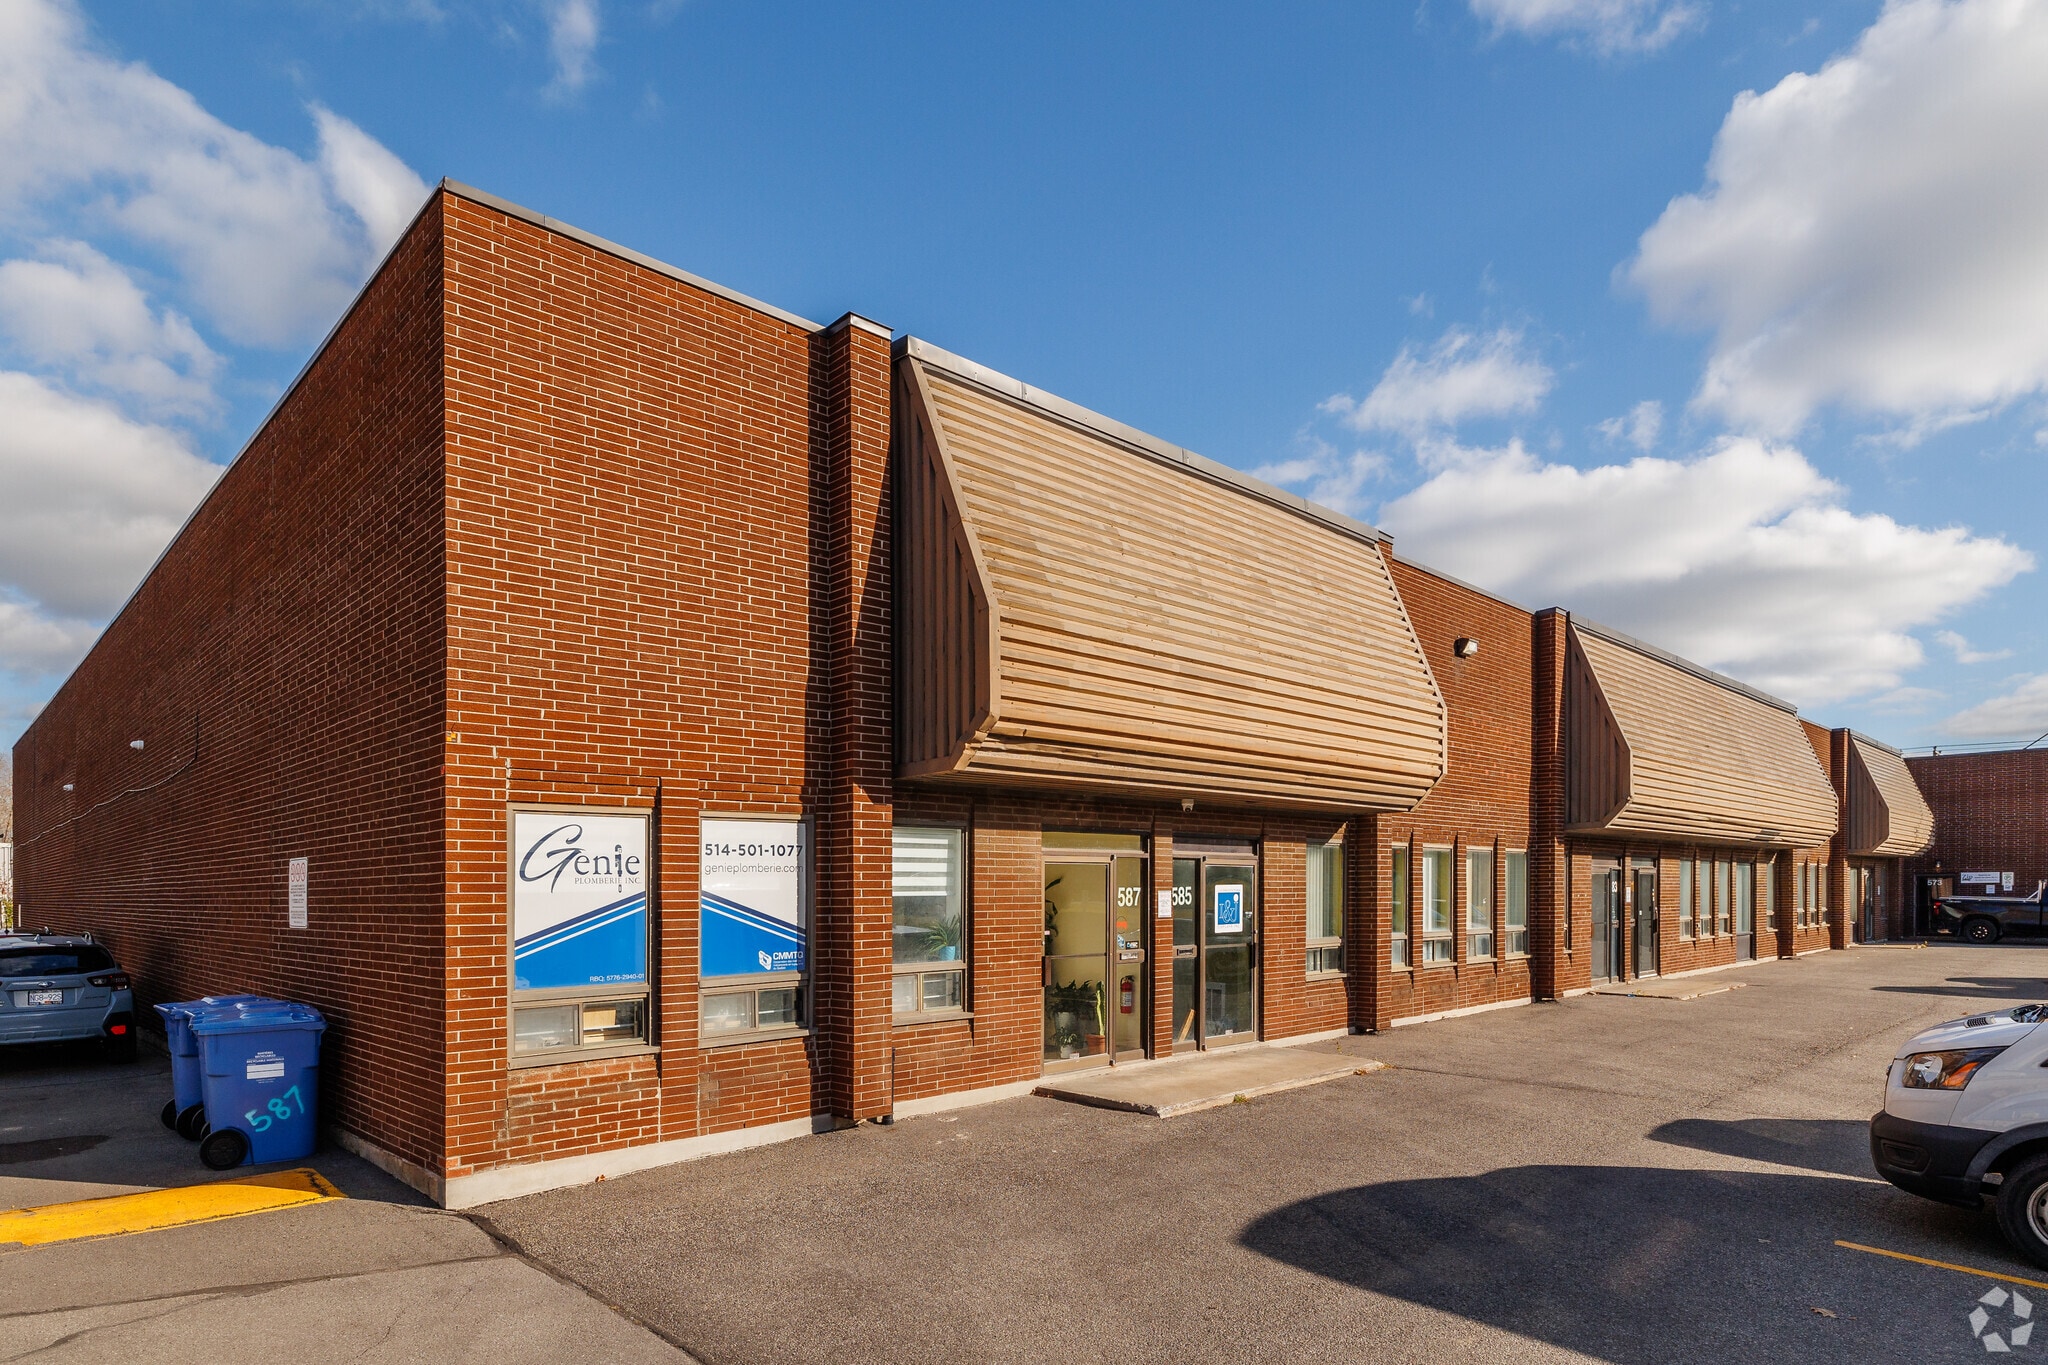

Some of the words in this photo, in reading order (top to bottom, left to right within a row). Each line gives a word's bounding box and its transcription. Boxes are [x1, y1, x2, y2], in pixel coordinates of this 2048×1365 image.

[519, 824, 641, 893] Genie
[704, 843, 803, 857] 514-501-1077
[704, 862, 804, 875] genieplomberie.com
[574, 877, 622, 885] PLOMBERIE
[1117, 886, 1141, 907] 587
[1172, 886, 1192, 906] 585
[772, 951, 804, 960] CMMTQ
[244, 1084, 305, 1132] 587
